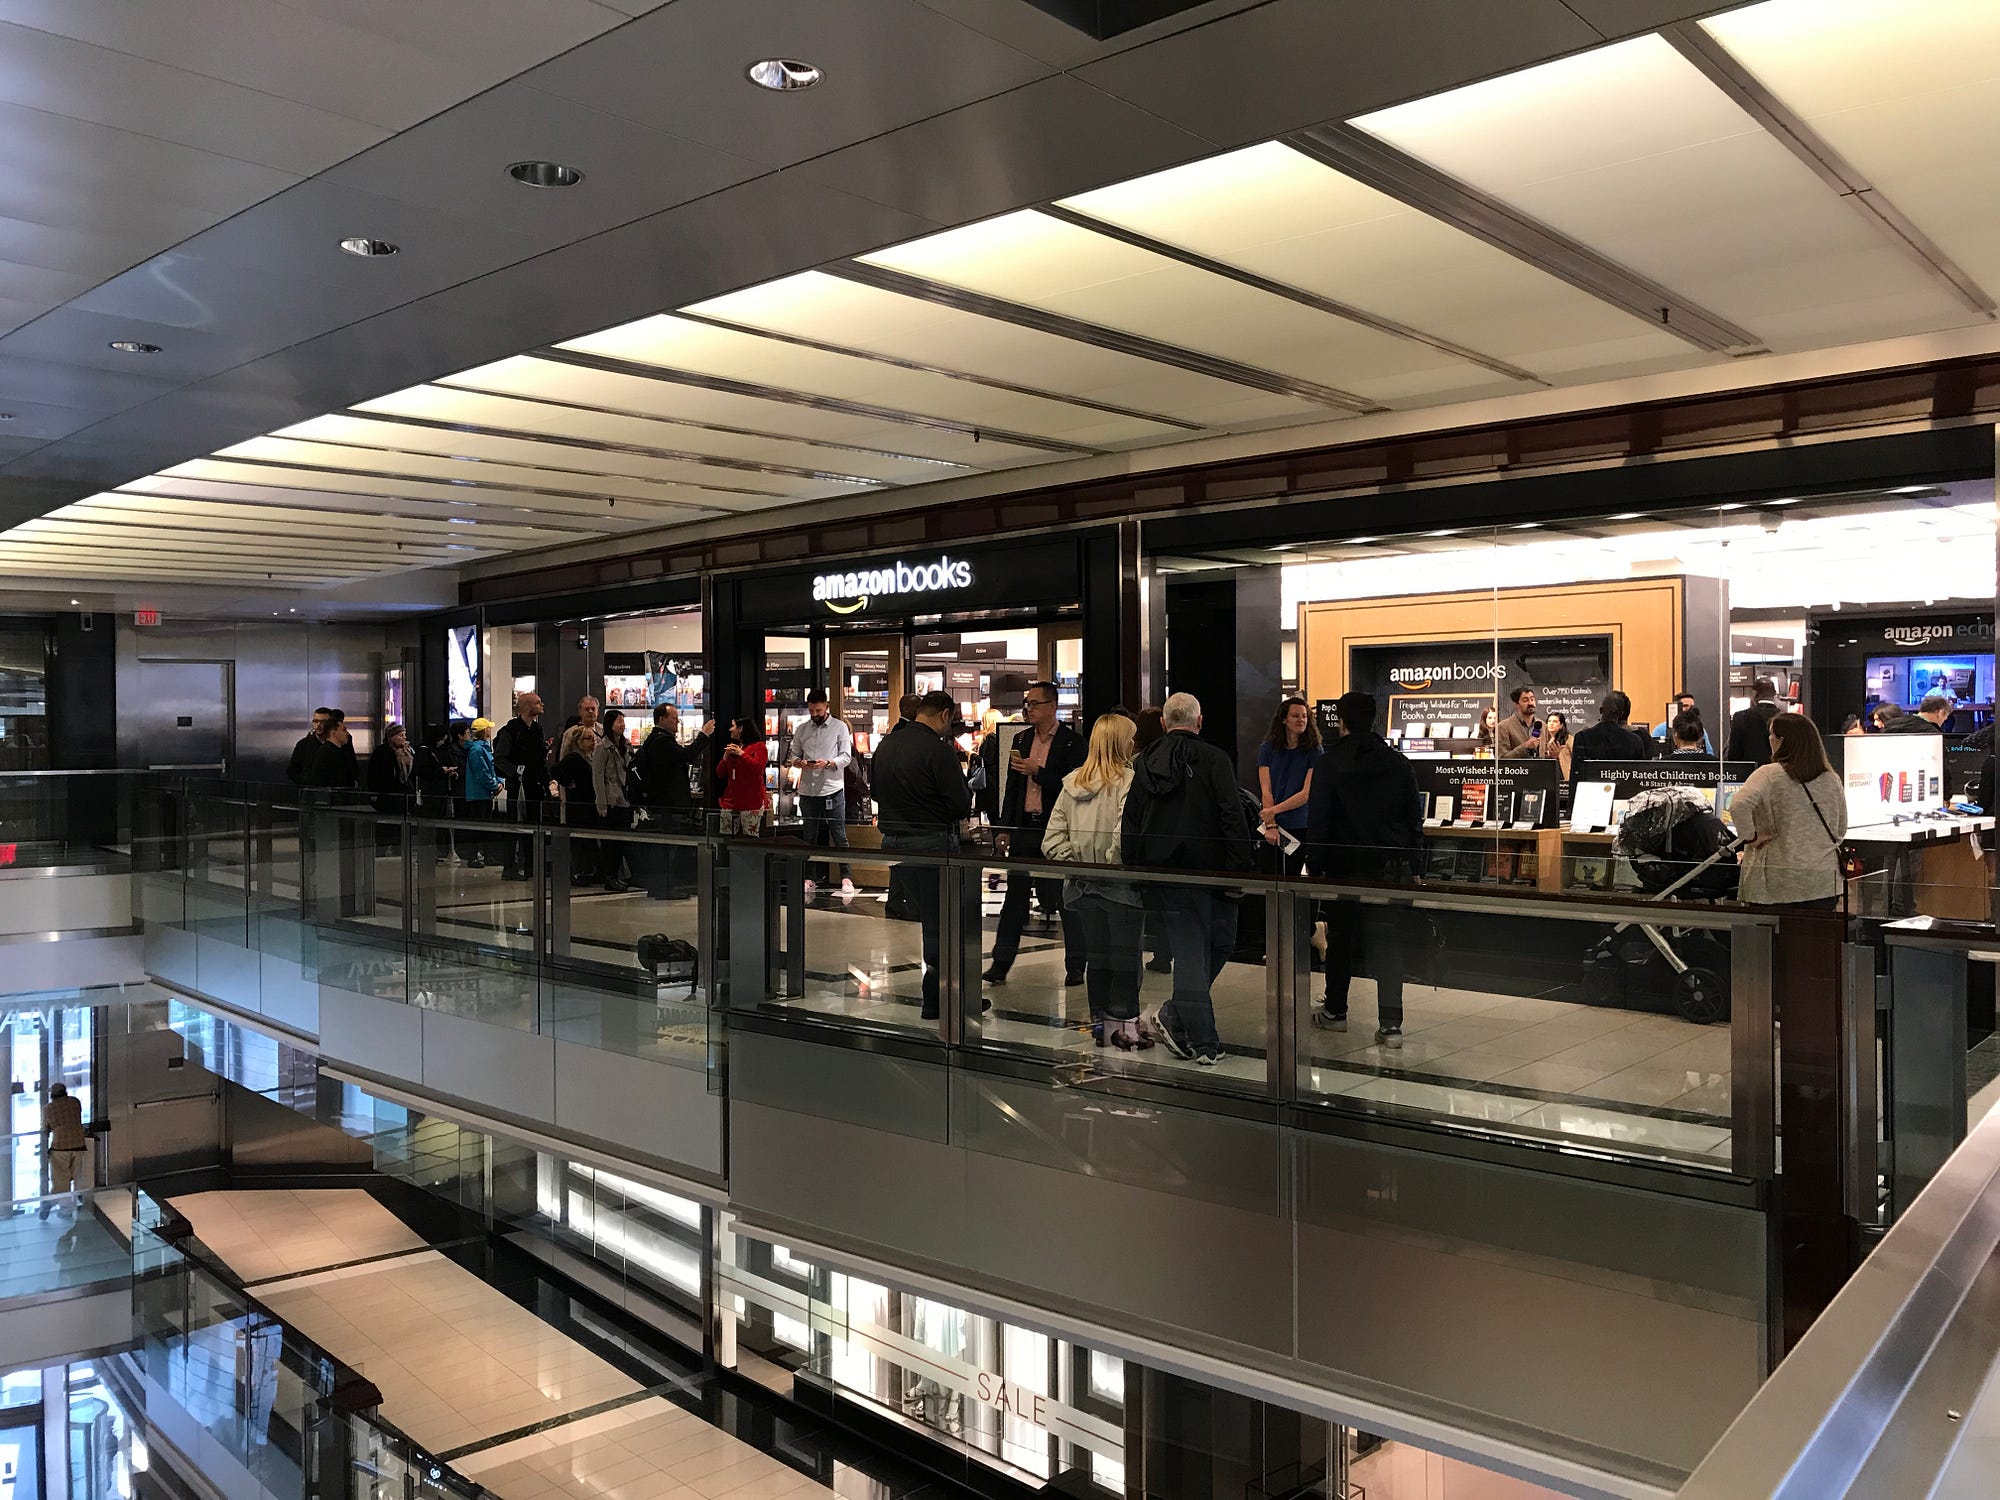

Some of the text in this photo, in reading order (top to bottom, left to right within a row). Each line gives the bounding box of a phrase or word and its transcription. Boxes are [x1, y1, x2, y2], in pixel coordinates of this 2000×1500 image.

[138, 611, 158, 625] EXIT
[1884, 624, 1953, 640] amazon
[1542, 686, 1557, 695] Over
[1399, 700, 1429, 711] Frequently
[1461, 699, 1480, 709] Travel
[1401, 710, 1425, 720] Books
[1436, 710, 1472, 719] Amazon.com
[1950, 744, 1963, 752] and
[1435, 765, 1529, 775] Most-Wished-For Books
[1600, 769, 1737, 781] Highly Rated Children's Books
[1461, 777, 1514, 786] Amazon.com
[977, 1372, 1047, 1428] SALE
